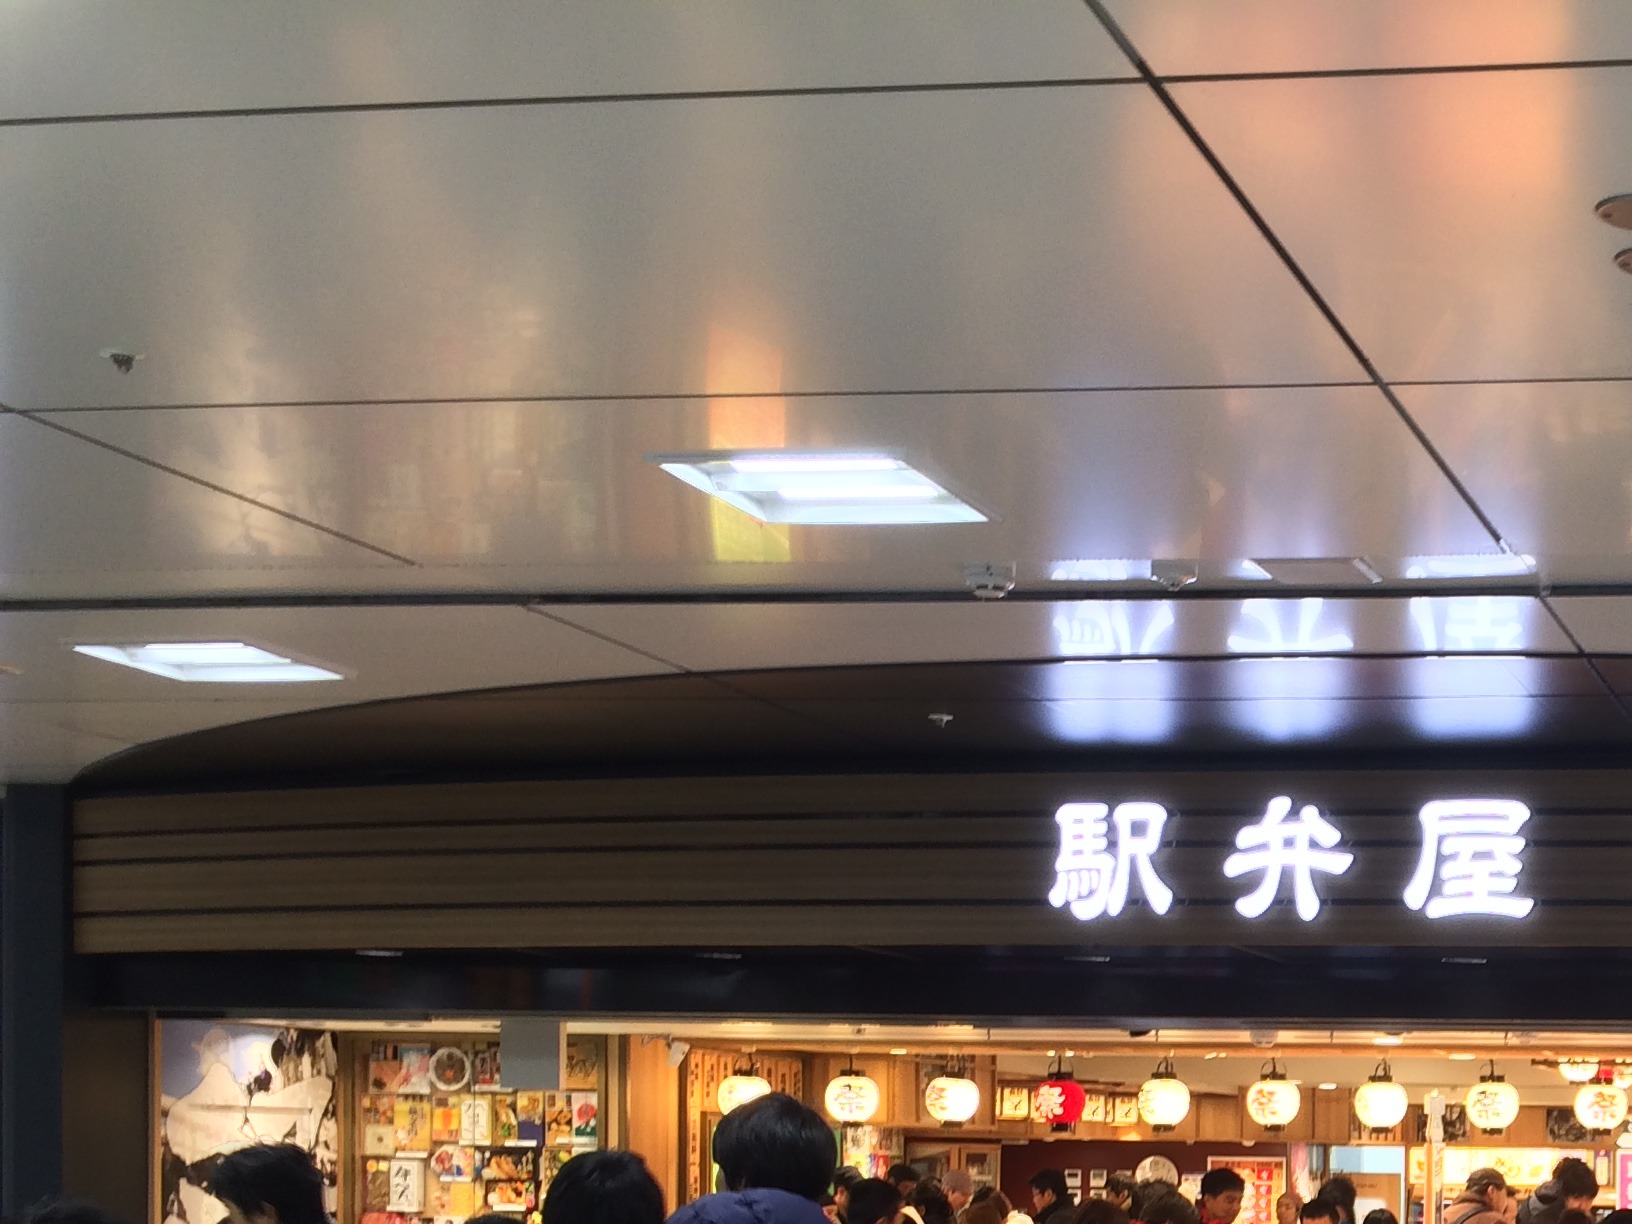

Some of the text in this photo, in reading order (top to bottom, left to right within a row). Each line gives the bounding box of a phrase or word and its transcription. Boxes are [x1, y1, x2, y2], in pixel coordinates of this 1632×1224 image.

[1046, 794, 1537, 922] 駅弁屋
[1587, 1090, 1619, 1122] 祭
